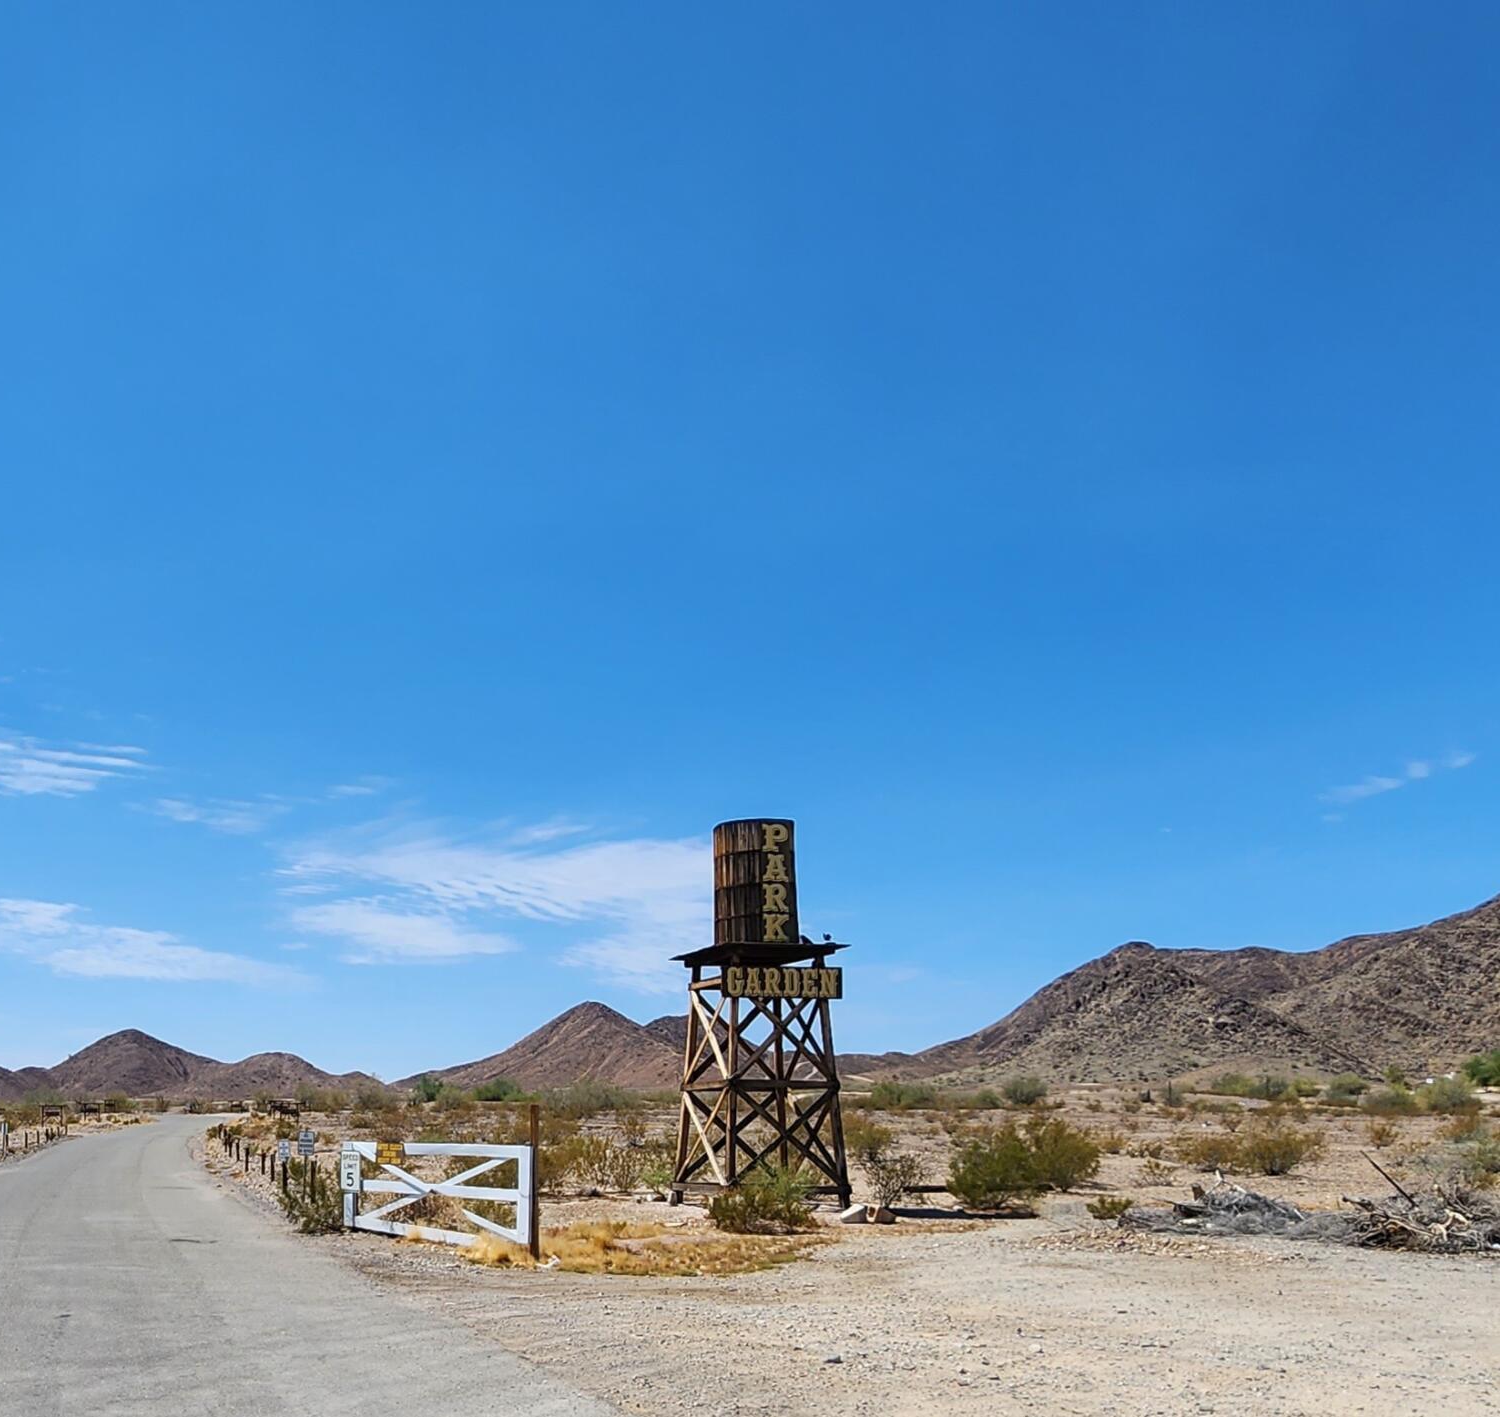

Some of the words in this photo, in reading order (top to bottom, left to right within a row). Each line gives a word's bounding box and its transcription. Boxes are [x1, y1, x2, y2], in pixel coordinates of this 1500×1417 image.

[762, 824, 789, 942] PARK
[727, 966, 839, 998] GARDEN
[346, 1172, 355, 1187] 5
